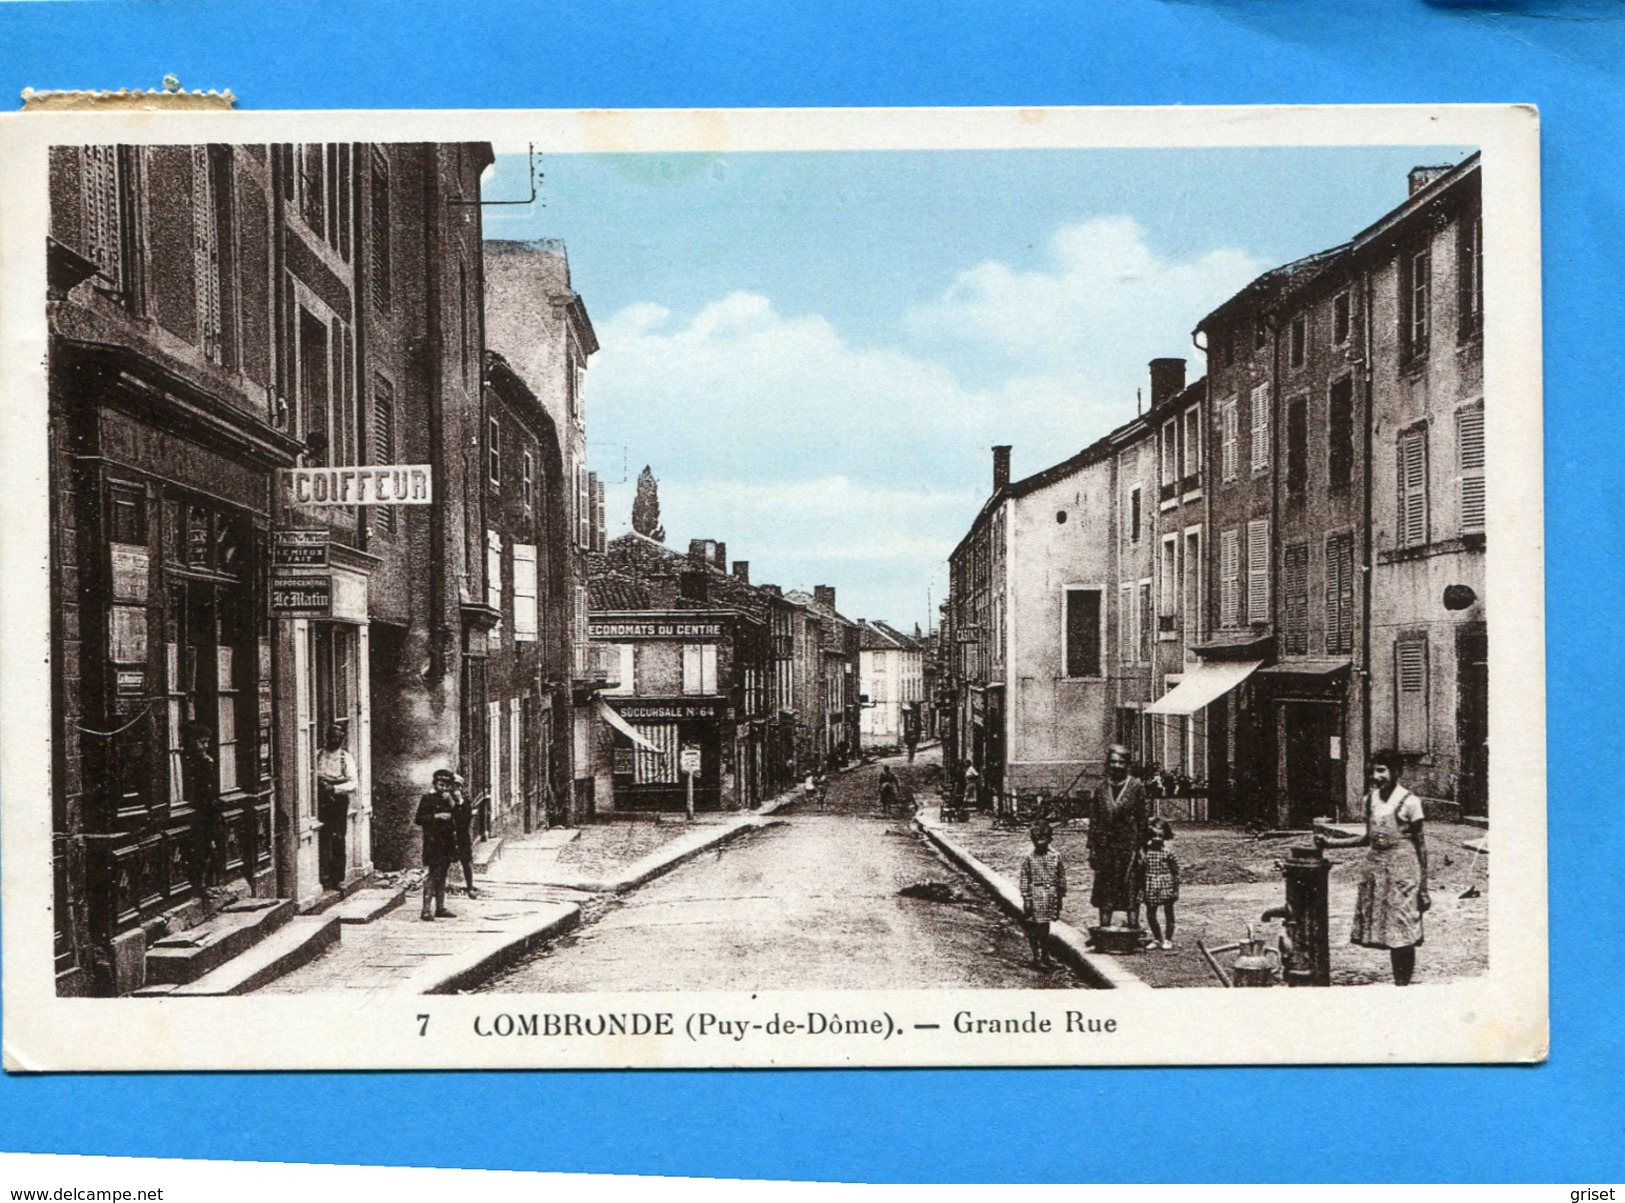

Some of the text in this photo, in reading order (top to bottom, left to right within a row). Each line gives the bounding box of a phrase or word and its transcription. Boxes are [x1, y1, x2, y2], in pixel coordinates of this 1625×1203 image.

[296, 470, 427, 502] COIFFEUR
[273, 591, 328, 608] Le Matin
[588, 624, 721, 635] ECONOMATS DU CENTRE
[700, 706, 715, 717] 64
[416, 1013, 431, 1037] 7
[473, 1013, 675, 1037] COMBRONDE
[685, 1011, 904, 1042] (Puy-de-Dôme).
[953, 1010, 1052, 1034] Grande
[1065, 1010, 1118, 1034] Rue
